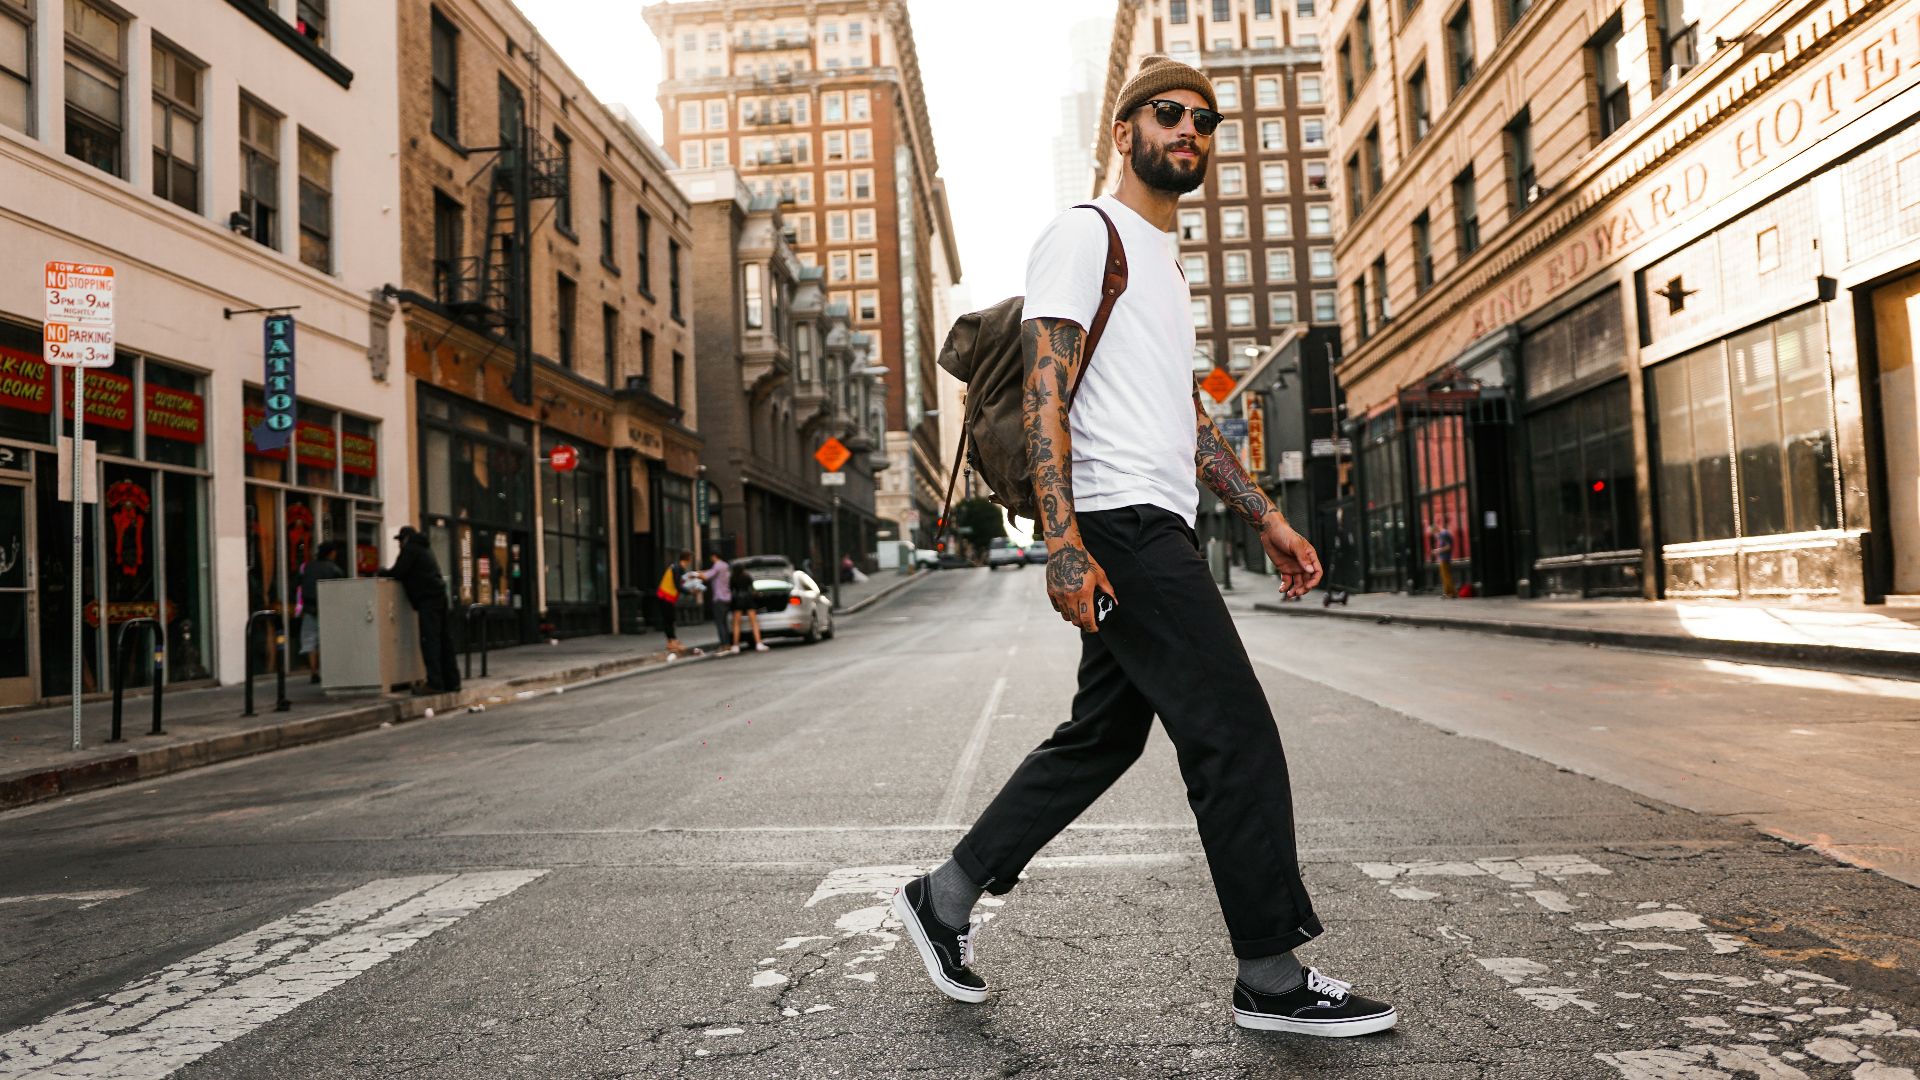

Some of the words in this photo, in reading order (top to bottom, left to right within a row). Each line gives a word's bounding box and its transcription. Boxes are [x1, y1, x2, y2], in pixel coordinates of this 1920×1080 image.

[896, 155, 911, 257] HOTEL
[47, 271, 66, 288] NO
[69, 278, 111, 291] STOPPING
[1471, 275, 1534, 339] KING
[1543, 162, 1708, 294] EDWARD
[47, 325, 66, 342] NO
[69, 329, 111, 344] PARKING
[64, 307, 96, 316] NIGHTLY
[267, 319, 293, 431] TATTOO
[901, 276, 919, 420] ROSSLYN
[70, 400, 127, 421] CASSIC
